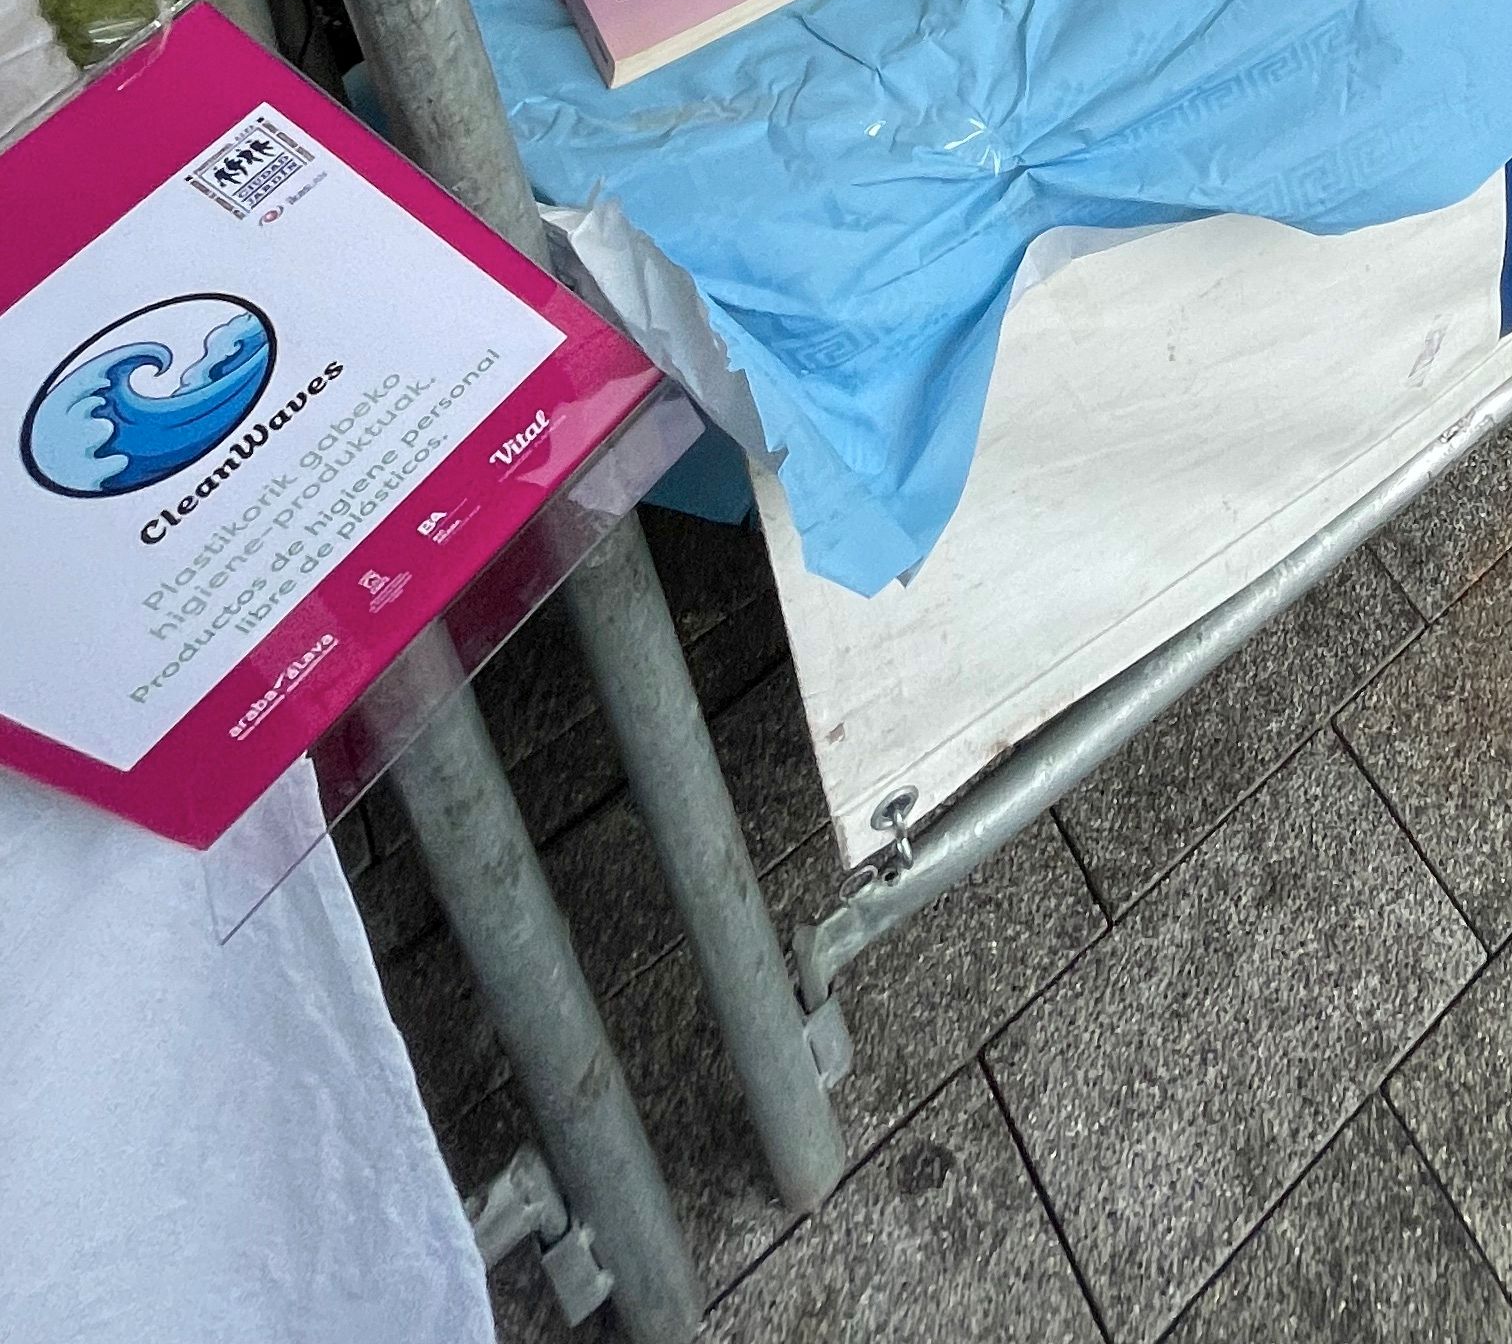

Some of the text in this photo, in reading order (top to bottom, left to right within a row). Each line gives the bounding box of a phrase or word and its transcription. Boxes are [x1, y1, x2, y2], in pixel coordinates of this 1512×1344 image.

[129, 576, 268, 704] Productos
[271, 540, 304, 573] de
[304, 448, 399, 537] higiene
[400, 348, 501, 449] personal
[140, 359, 344, 546] CleanWaves
[143, 473, 299, 611] Plastikorik
[299, 373, 400, 469] gabeko
[489, 409, 550, 466] Vital
[234, 578, 297, 636] libre
[300, 543, 334, 575] de
